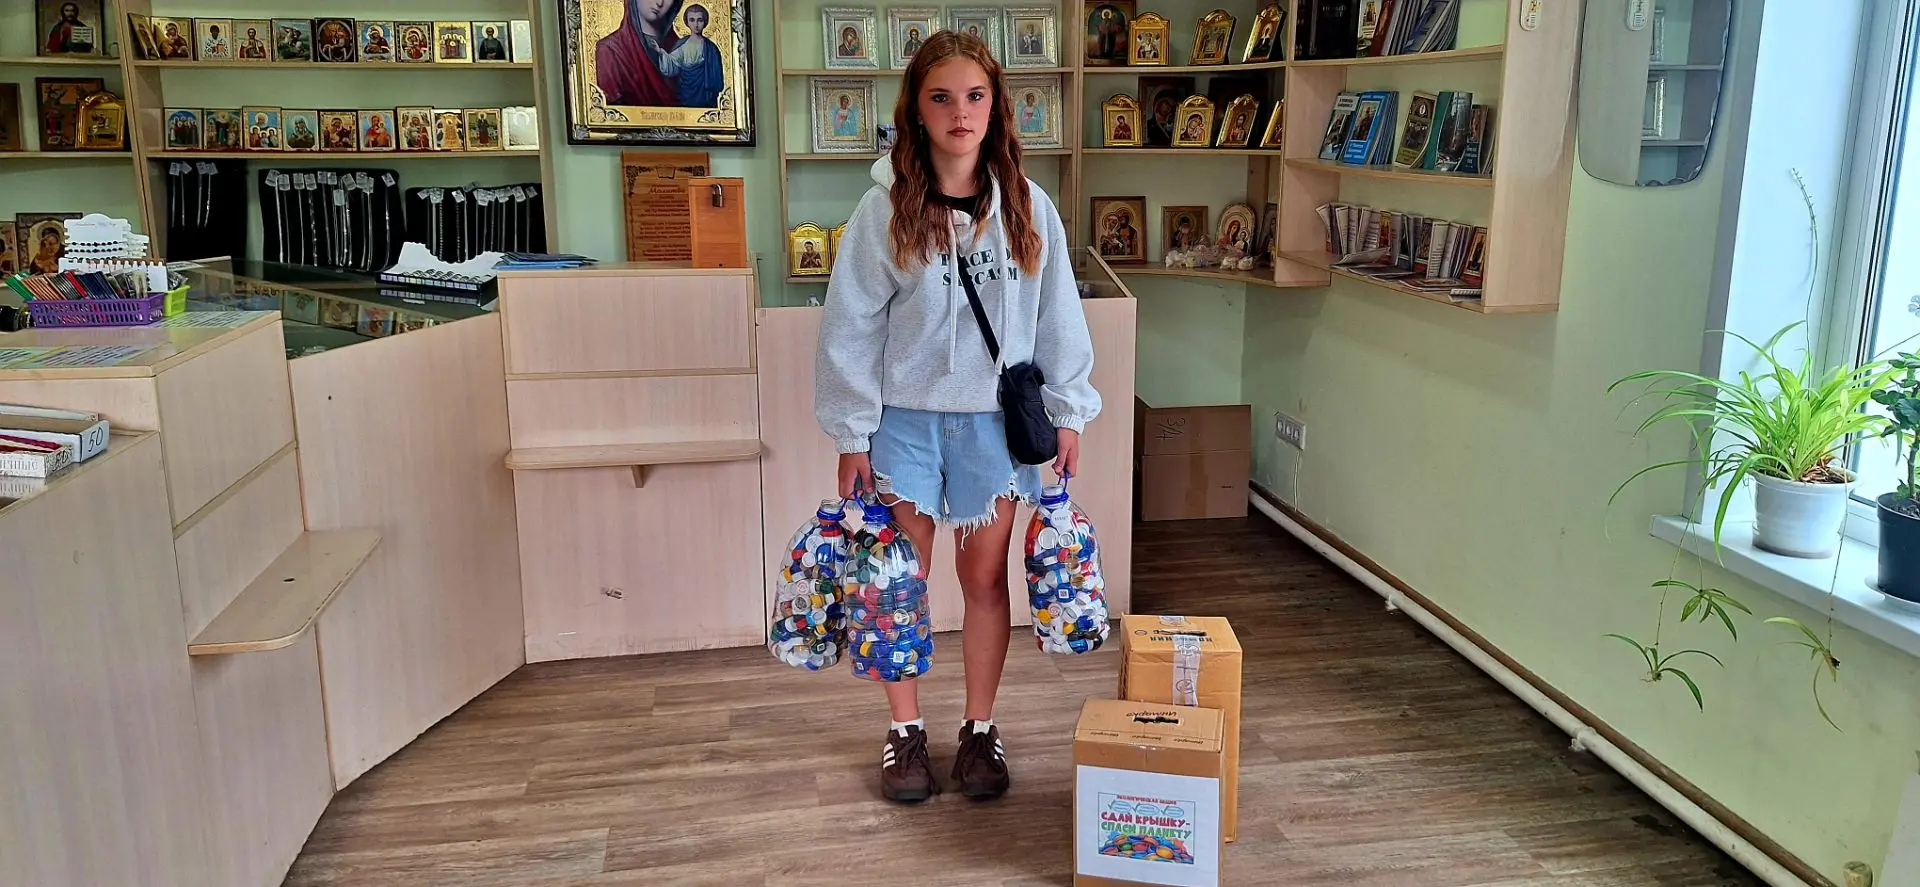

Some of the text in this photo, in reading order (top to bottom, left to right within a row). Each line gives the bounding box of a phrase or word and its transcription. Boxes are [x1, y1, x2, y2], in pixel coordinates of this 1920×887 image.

[938, 249, 994, 266] TCE
[942, 267, 1018, 286] SCAM
[88, 426, 104, 452] 50
[1101, 811, 1132, 823] СДАЙ
[1101, 821, 1192, 839] СПАСИ ПЛАНЕТУ
